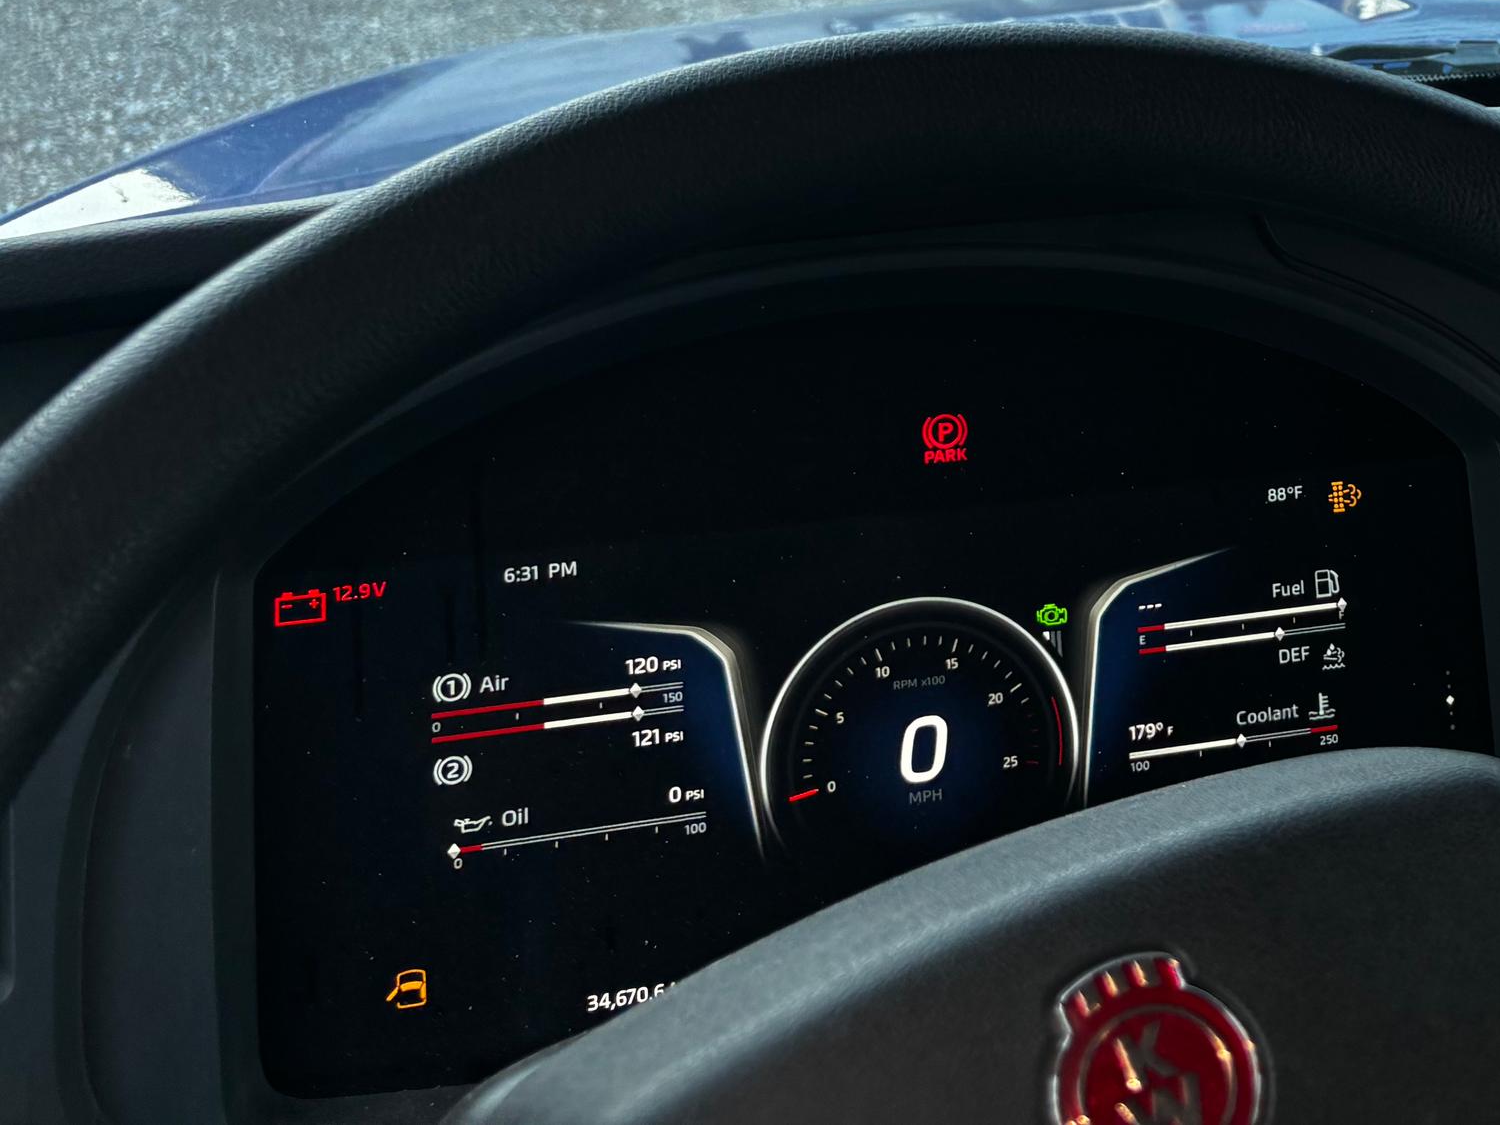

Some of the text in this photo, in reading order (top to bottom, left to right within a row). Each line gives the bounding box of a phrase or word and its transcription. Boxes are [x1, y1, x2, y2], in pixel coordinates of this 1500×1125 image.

[924, 448, 968, 464] PARK
[1267, 486, 1303, 502] 88°F
[503, 561, 578, 583] 6:31 PM
[333, 582, 387, 602] 12.9V
[1273, 580, 1305, 598] Fuel
[1139, 635, 1146, 645] E
[1279, 646, 1310, 664] DEF
[625, 656, 682, 674] 120 PSI
[876, 666, 891, 678] 10
[946, 658, 959, 670] 15
[480, 674, 509, 694] Air
[893, 674, 946, 690] RPM x100
[662, 691, 683, 703] 150
[988, 691, 1004, 706] 20
[836, 711, 845, 723] 5
[1236, 704, 1299, 725] Coolant
[431, 721, 441, 733] 0
[632, 728, 684, 746] 121 PSI
[1320, 732, 1339, 745] 250
[900, 715, 948, 784] 0
[1003, 756, 1019, 769] 25
[1130, 759, 1150, 772] 100
[669, 786, 705, 803] 0 PSI
[827, 780, 837, 793] 0
[908, 789, 943, 805] MPH
[502, 807, 529, 826] Oil
[685, 821, 707, 835] 100
[452, 857, 463, 870] 0
